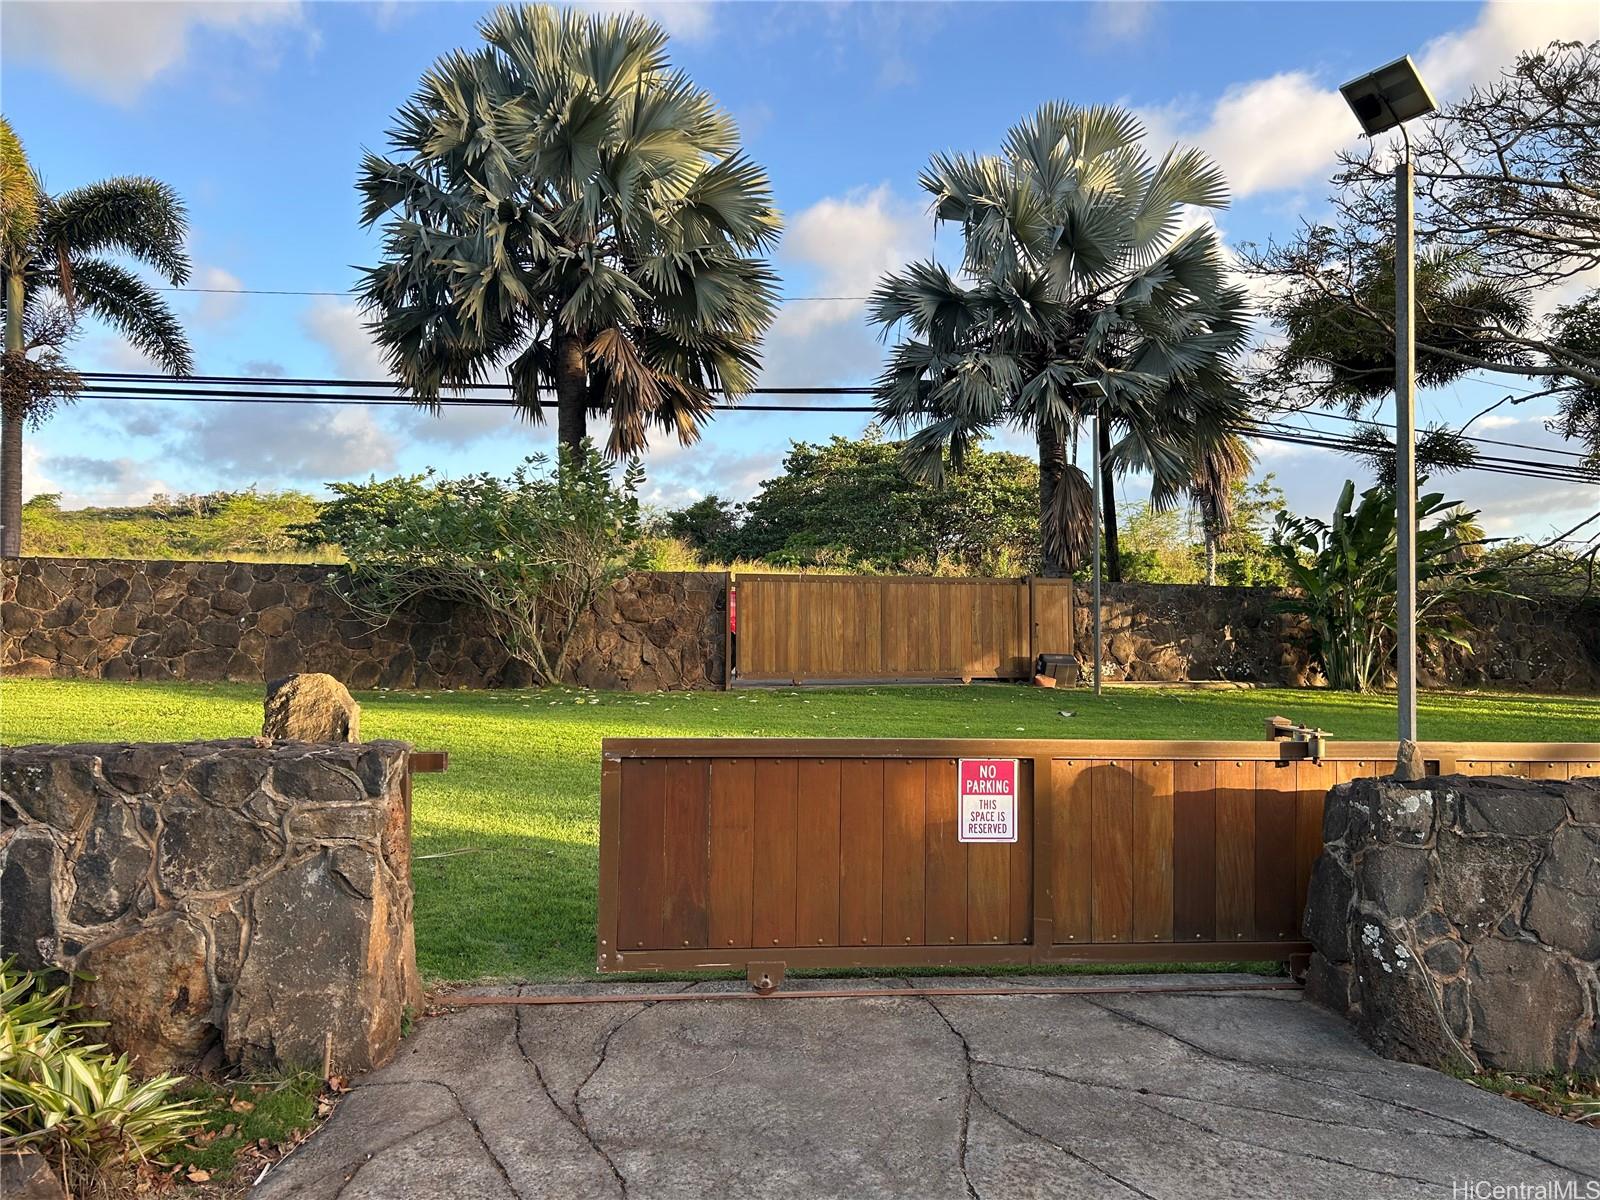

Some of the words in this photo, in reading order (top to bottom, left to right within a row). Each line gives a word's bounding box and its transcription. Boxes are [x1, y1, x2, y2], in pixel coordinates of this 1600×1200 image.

[979, 765, 997, 778] NO
[966, 780, 1009, 793] PARKING
[979, 800, 997, 810] THIS
[970, 811, 995, 822] SPACE
[998, 811, 1006, 822] IS
[968, 823, 1007, 834] RESERVED
